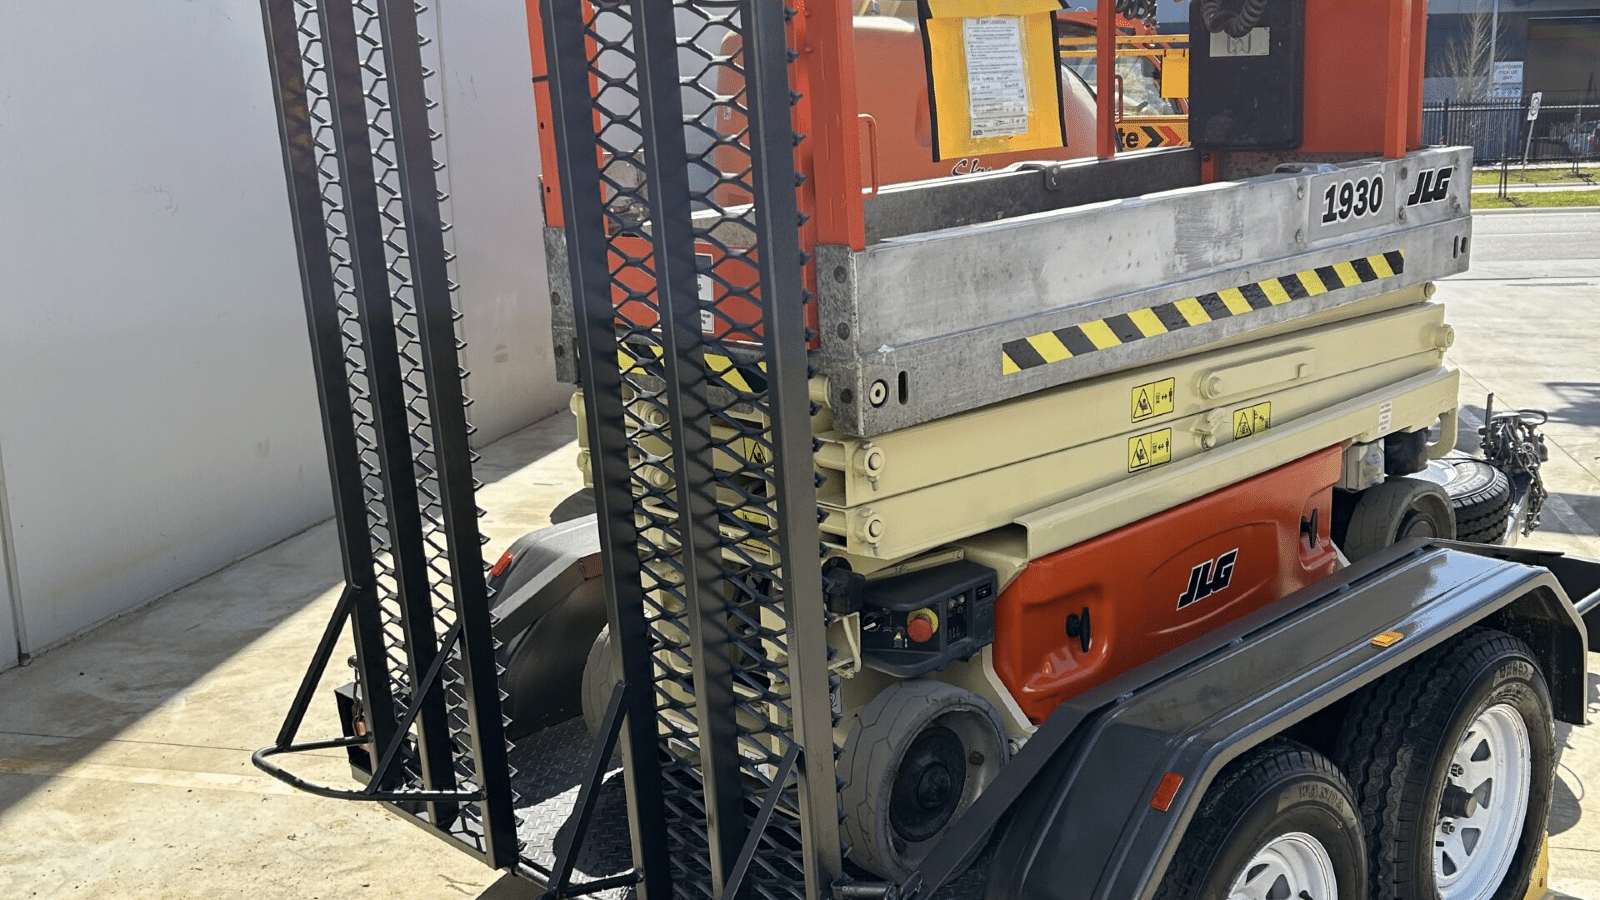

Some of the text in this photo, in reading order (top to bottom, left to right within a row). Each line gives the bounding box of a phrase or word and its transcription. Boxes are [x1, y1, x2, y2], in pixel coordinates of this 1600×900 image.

[1321, 173, 1384, 226] 1930
[1406, 165, 1454, 207] JLG
[1176, 547, 1239, 611] JLG
[1299, 784, 1345, 813] WANDA
